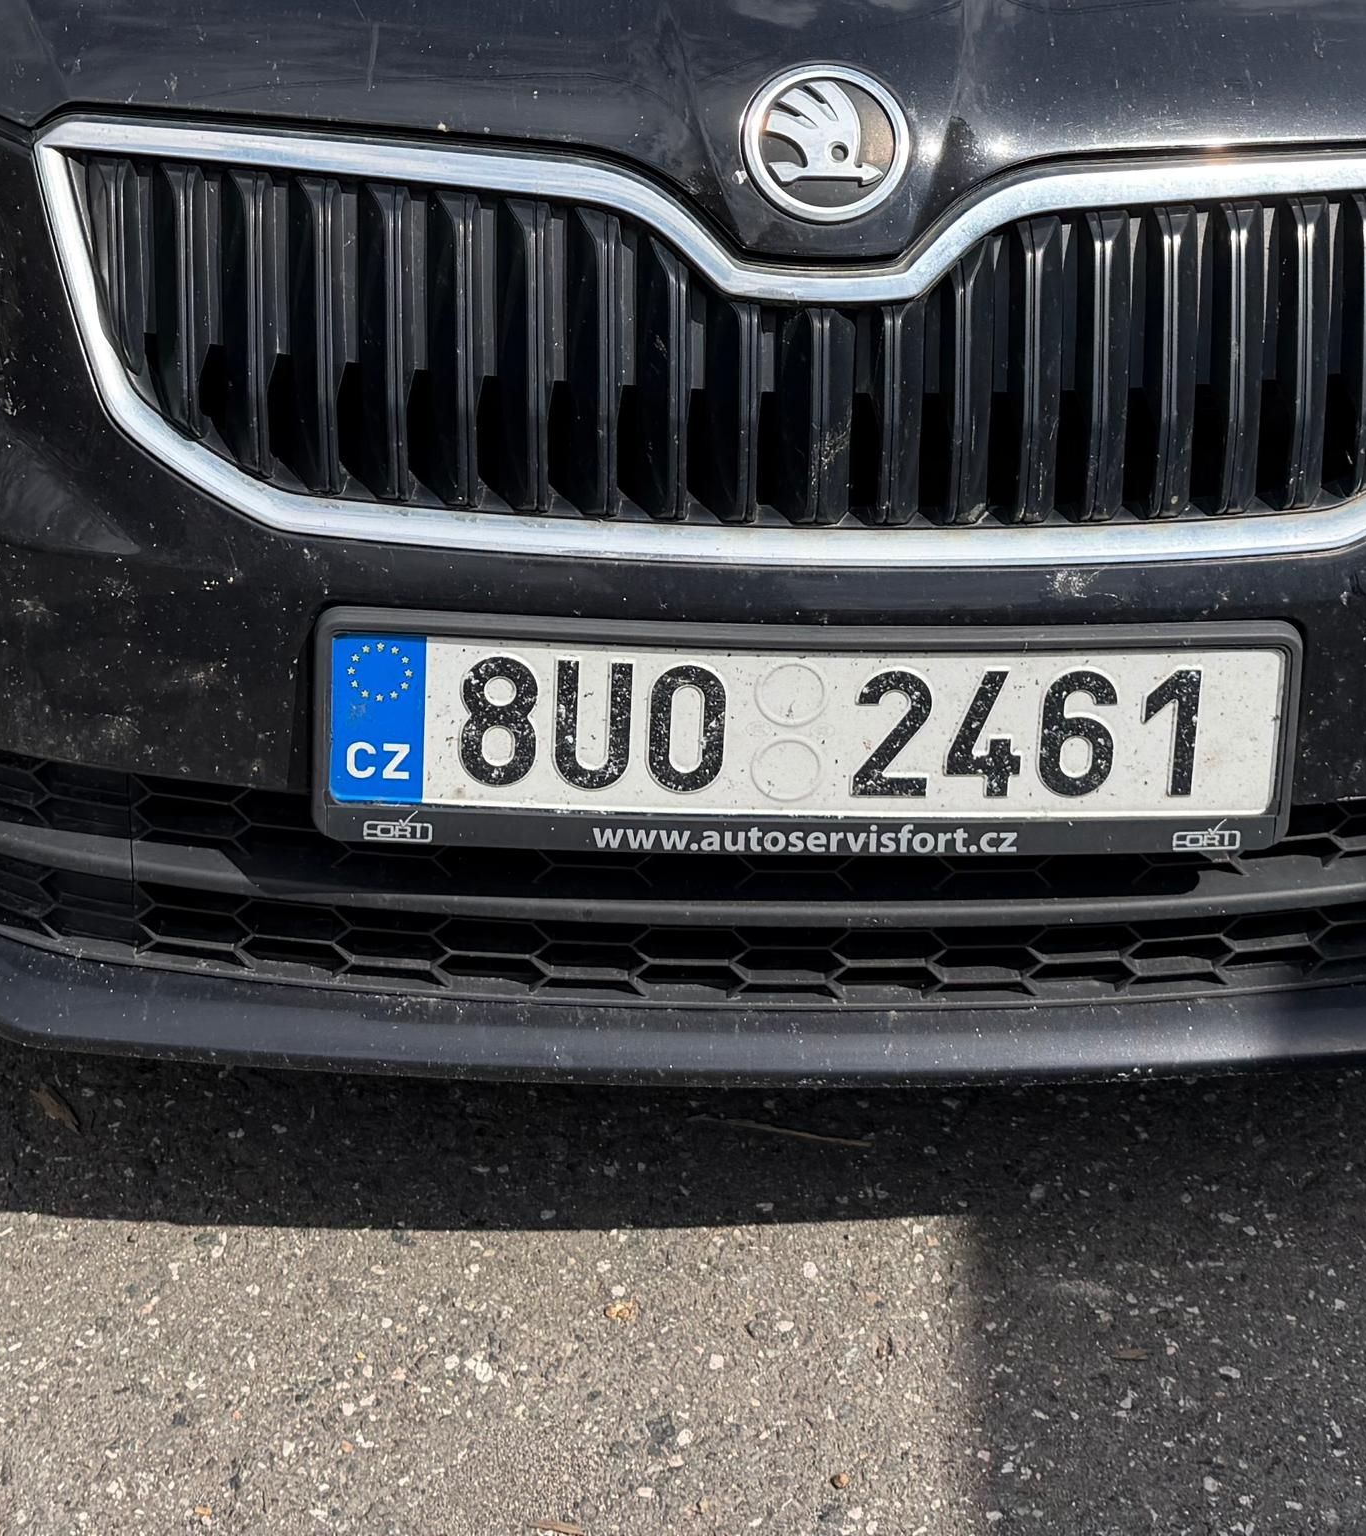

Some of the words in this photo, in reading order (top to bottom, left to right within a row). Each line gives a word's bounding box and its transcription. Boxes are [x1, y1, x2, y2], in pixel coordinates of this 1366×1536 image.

[459, 656, 727, 794] 8U0
[849, 668, 1203, 798] 2461
[345, 741, 411, 780] CZ
[592, 824, 1018, 854] www.autoservisfort.cz
